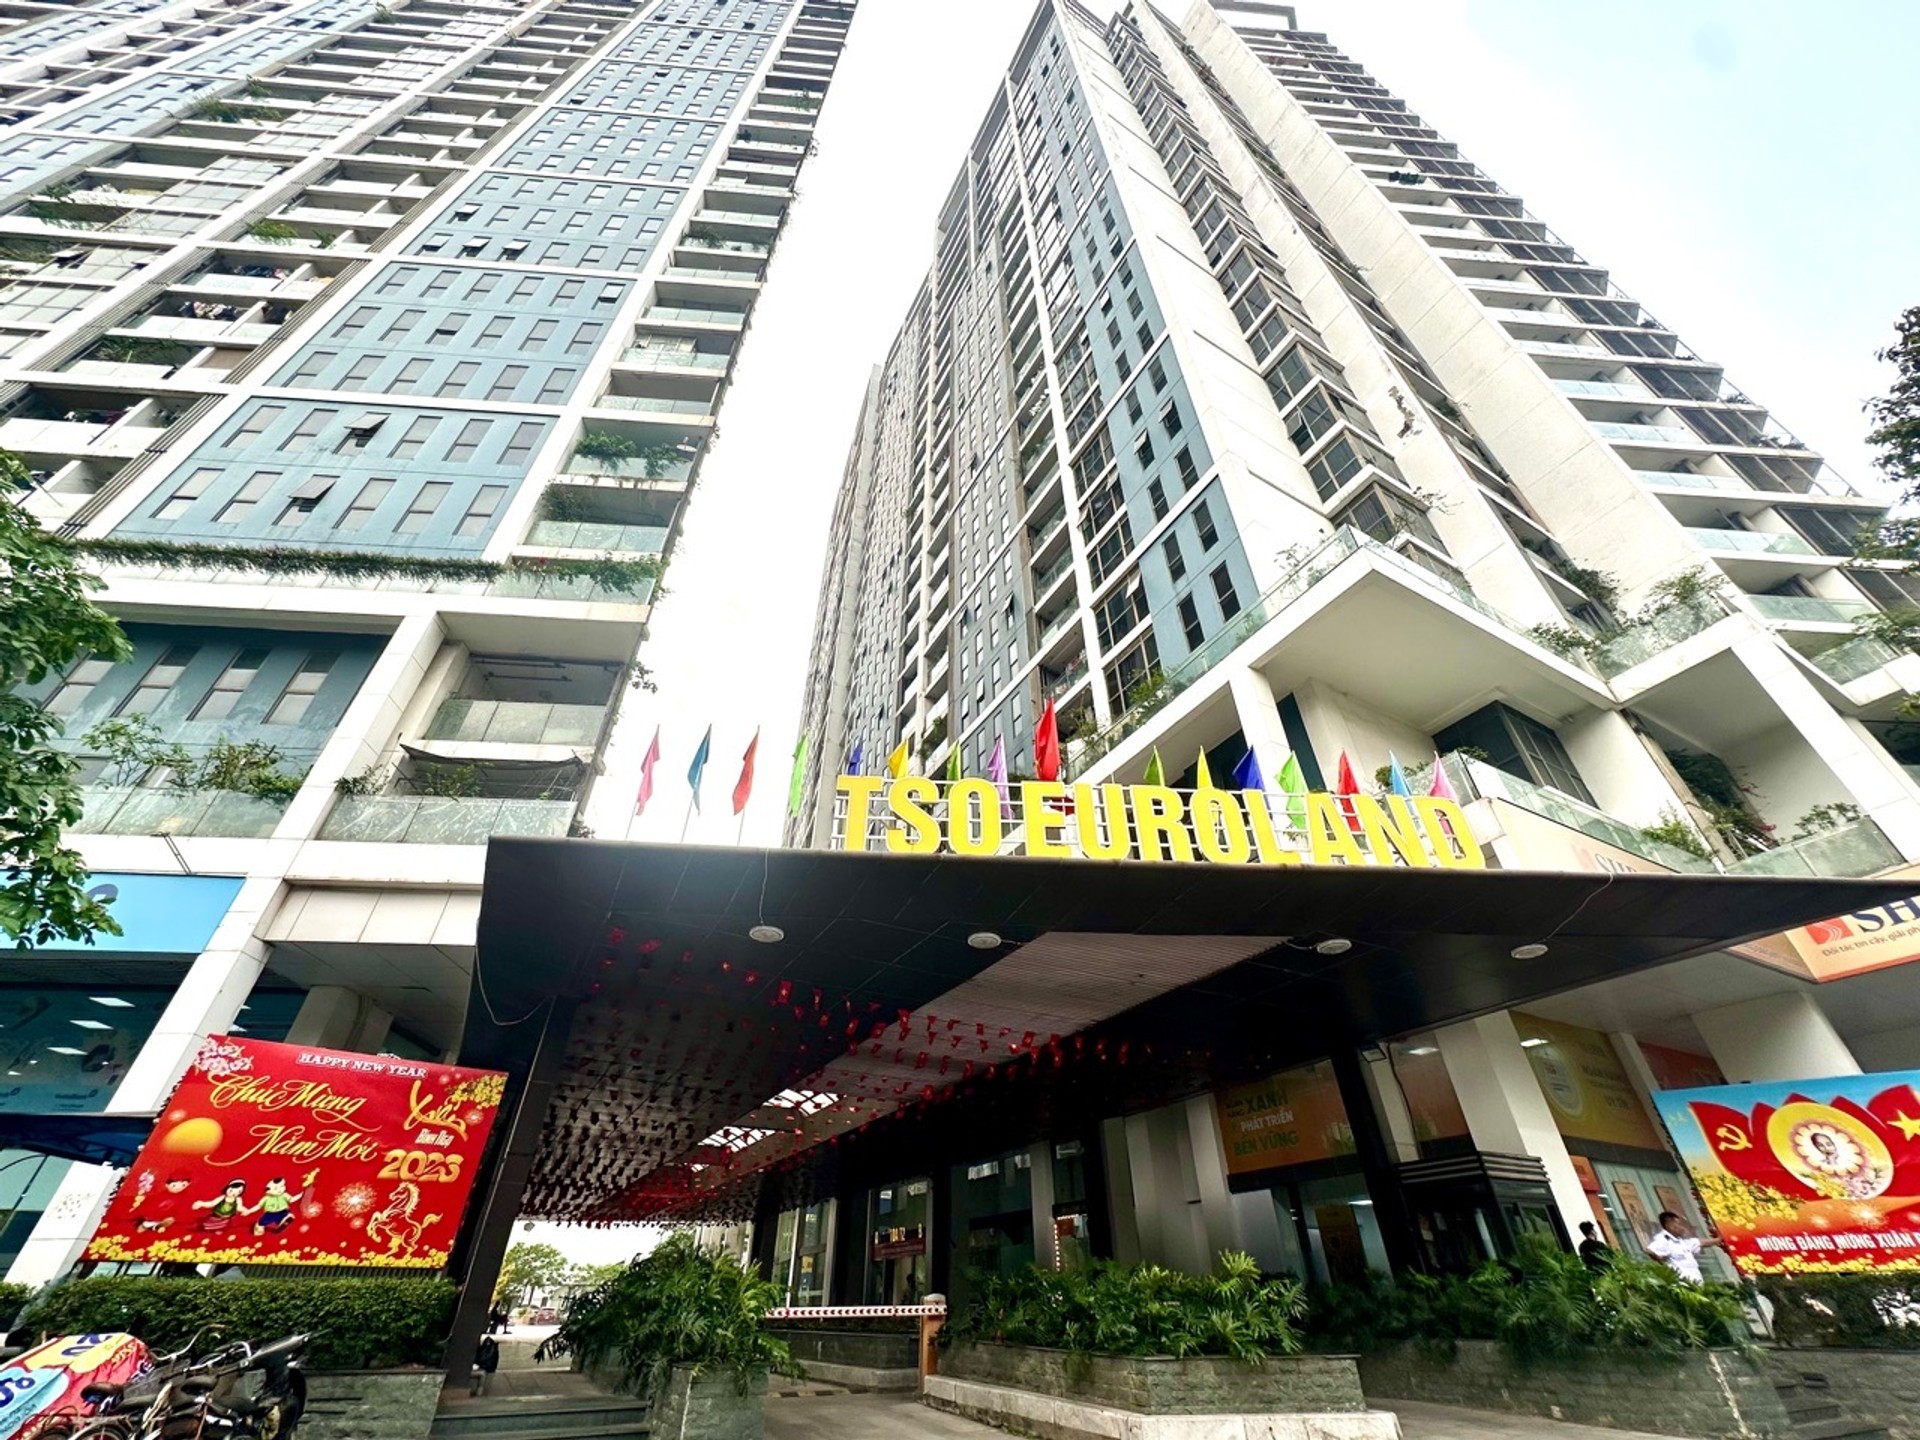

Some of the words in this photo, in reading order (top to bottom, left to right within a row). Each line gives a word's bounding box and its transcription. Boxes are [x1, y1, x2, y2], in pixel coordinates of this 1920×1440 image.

[836, 775, 1001, 856] TSO
[1021, 781, 1486, 869] EUROLAND
[299, 1053, 352, 1069] HAPPY
[352, 1059, 387, 1073] NEW
[387, 1064, 427, 1078] YEAR
[208, 1073, 287, 1108] Chúc
[1244, 1090, 1289, 1113] XANH
[1240, 1116, 1264, 1132] PHÁT
[292, 1130, 378, 1163] Mới
[1755, 1234, 1799, 1251] MỪNG
[1795, 1231, 1836, 1250] ĐẢNG
[1831, 1231, 1877, 1249] MỪNG
[1872, 1230, 1916, 1248] XUÂN
